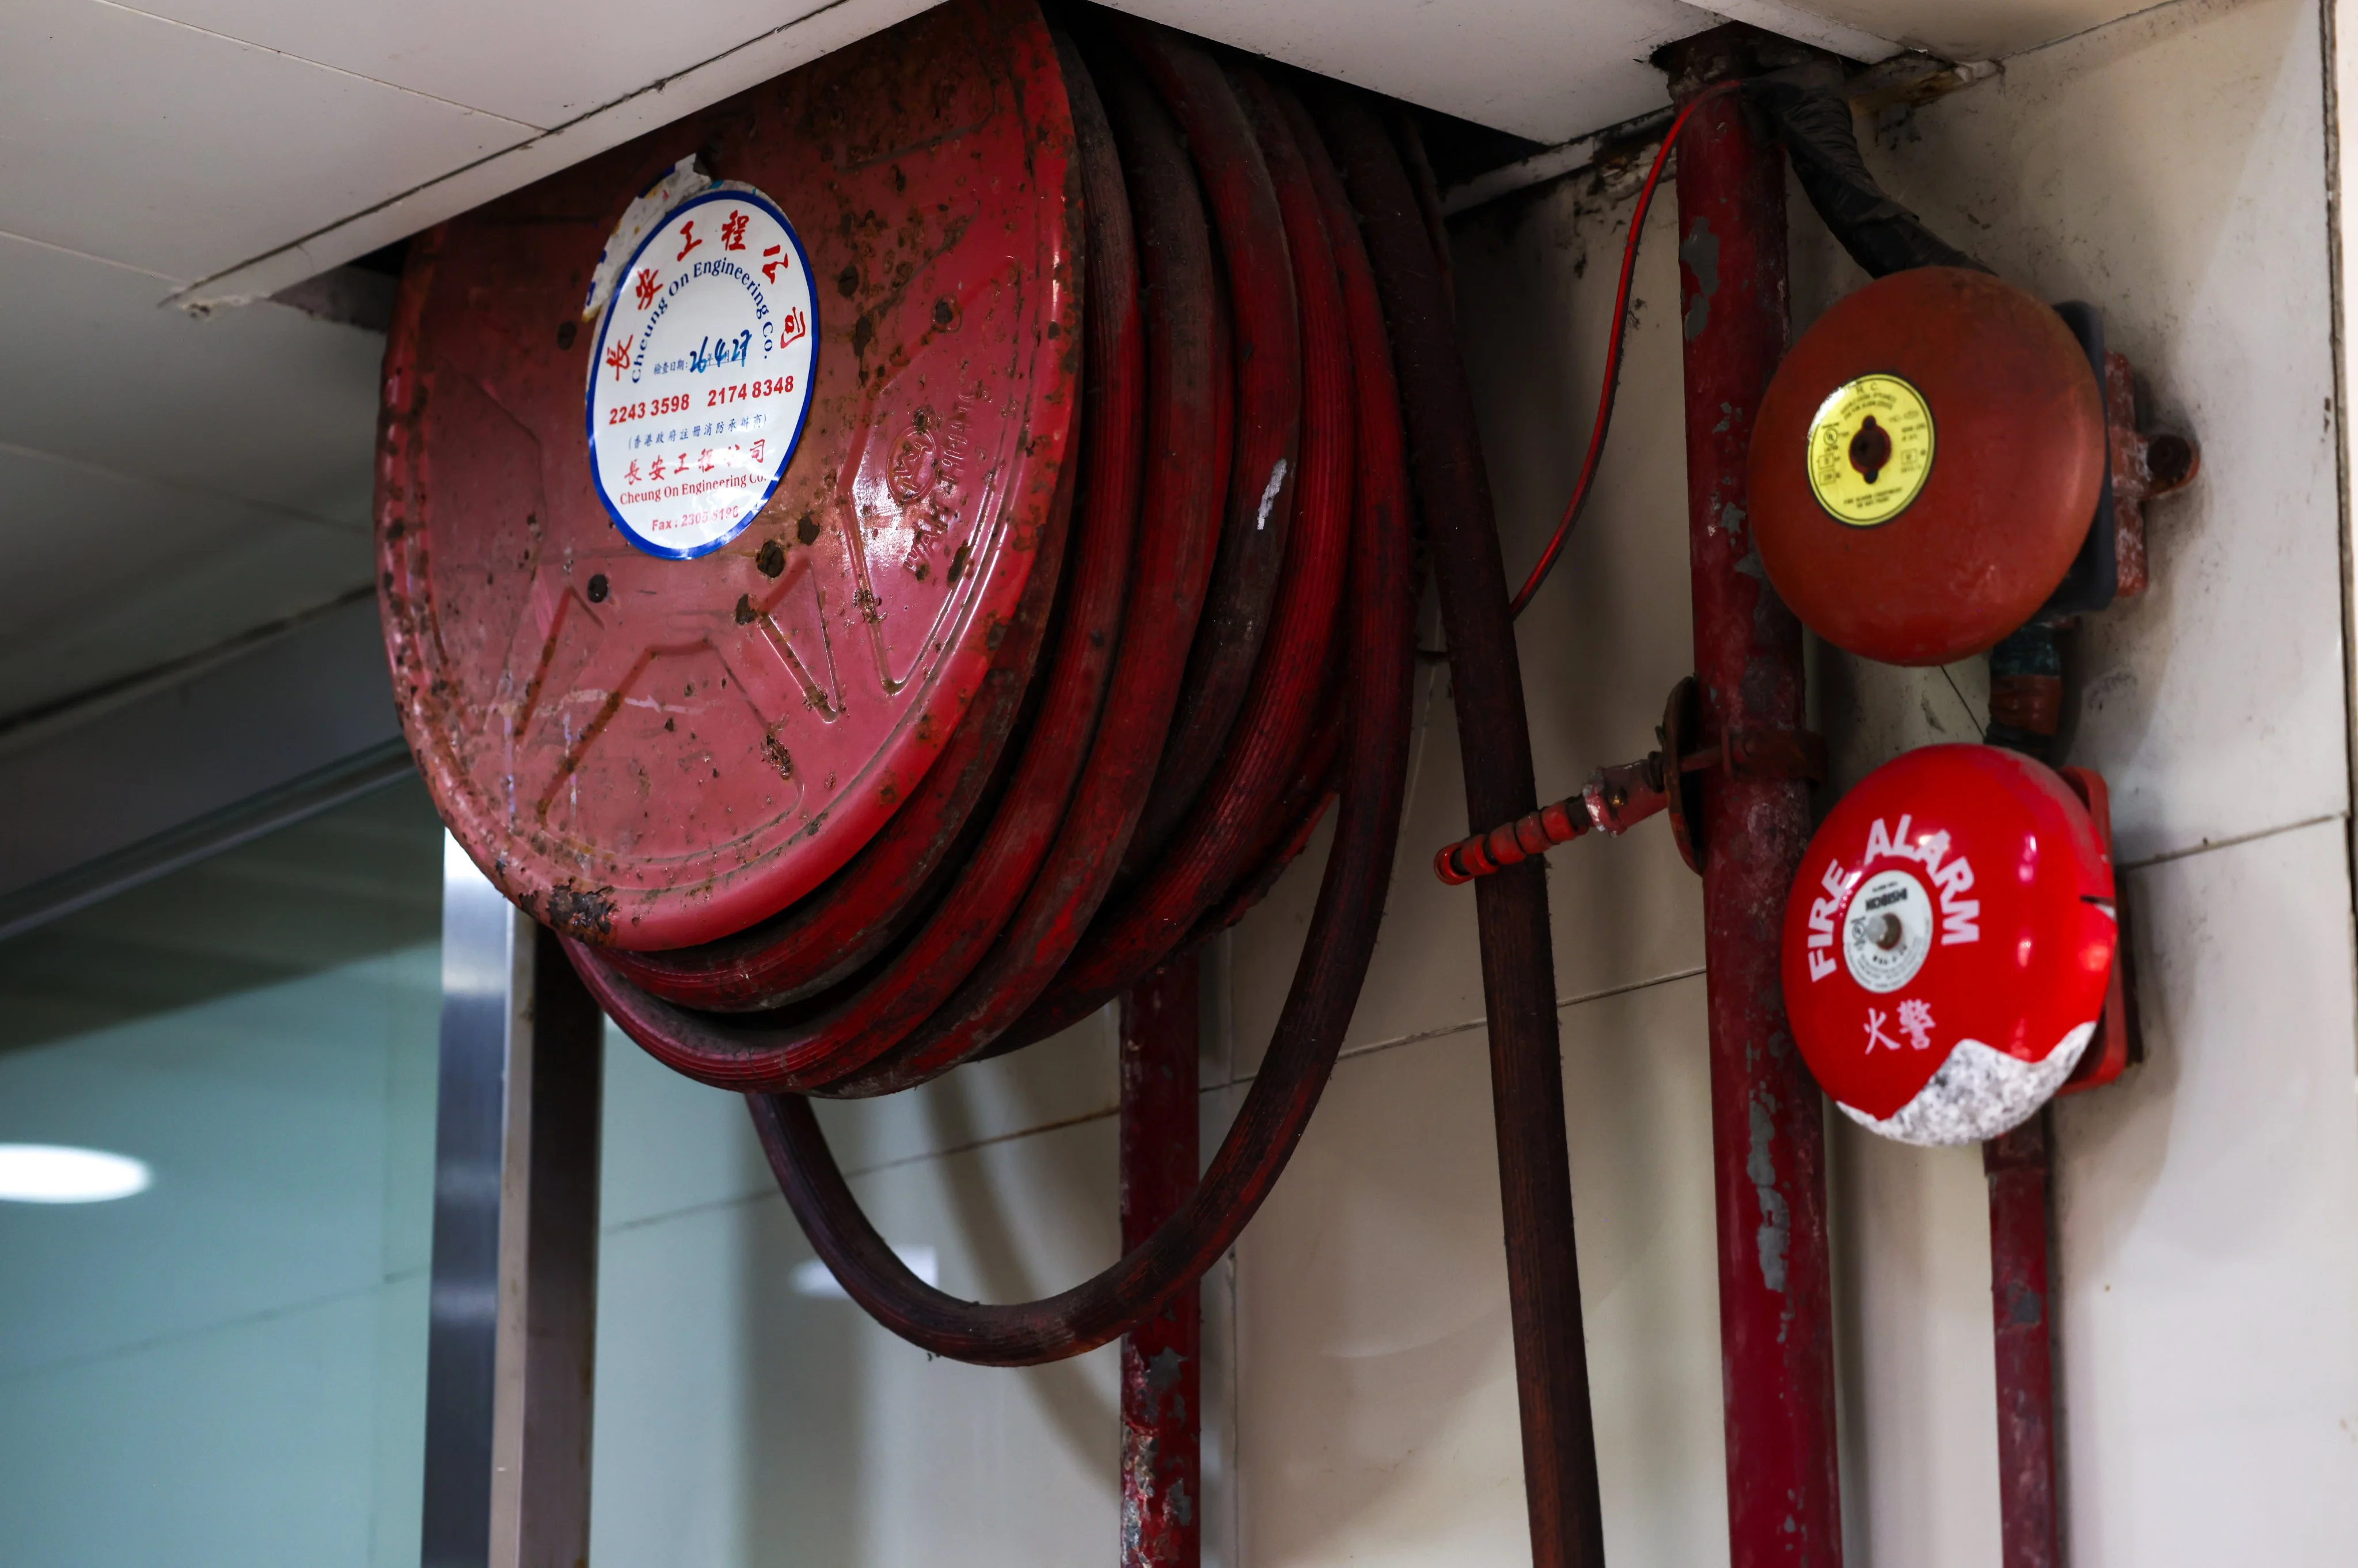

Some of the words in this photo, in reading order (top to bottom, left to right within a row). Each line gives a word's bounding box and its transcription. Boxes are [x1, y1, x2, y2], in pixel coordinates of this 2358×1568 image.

[632, 297, 669, 383] Cheung
[669, 273, 689, 297] On
[693, 257, 769, 320] Engineering
[762, 321, 773, 359] Co.
[609, 402, 645, 425] 2243
[650, 393, 690, 416] 3598
[707, 384, 747, 407] 2174
[752, 375, 794, 398] 8348
[620, 488, 662, 505] Cheung
[664, 486, 679, 498] On
[682, 474, 747, 495] Engineering
[1808, 859, 1850, 982] FIRE
[1865, 814, 1980, 945] ALARM
[1864, 999, 1936, 1055] 火警
